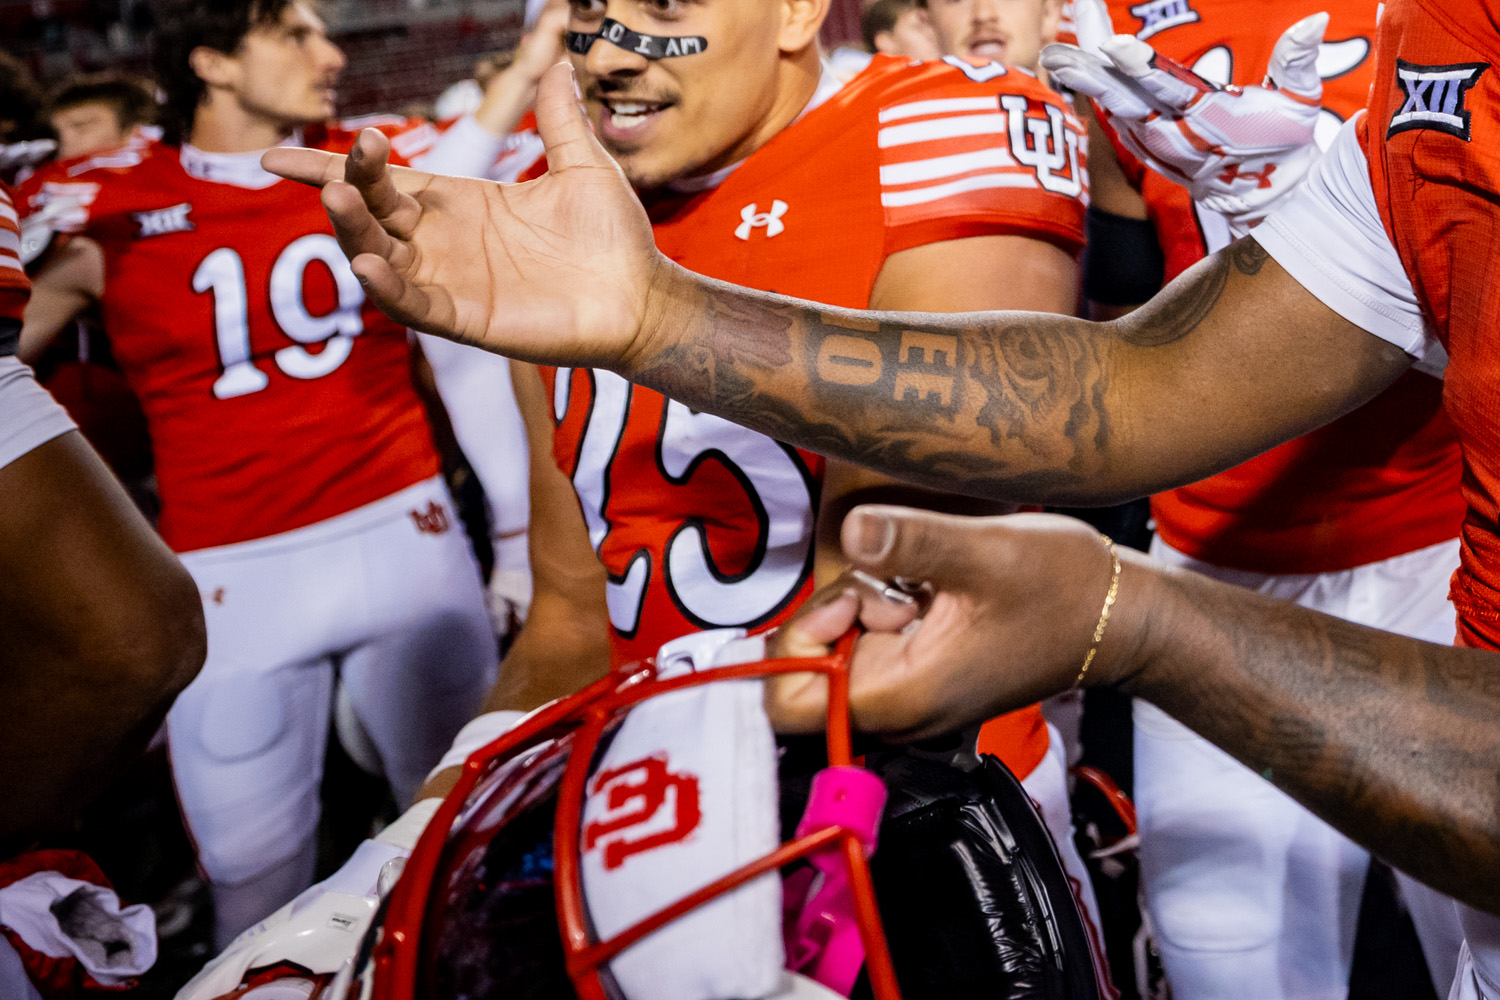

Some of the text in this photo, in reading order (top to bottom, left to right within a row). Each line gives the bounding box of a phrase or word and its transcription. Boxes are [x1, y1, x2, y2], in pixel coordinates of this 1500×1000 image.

[634, 35, 653, 54] I
[665, 37, 700, 56] AM
[192, 233, 367, 401] 19
